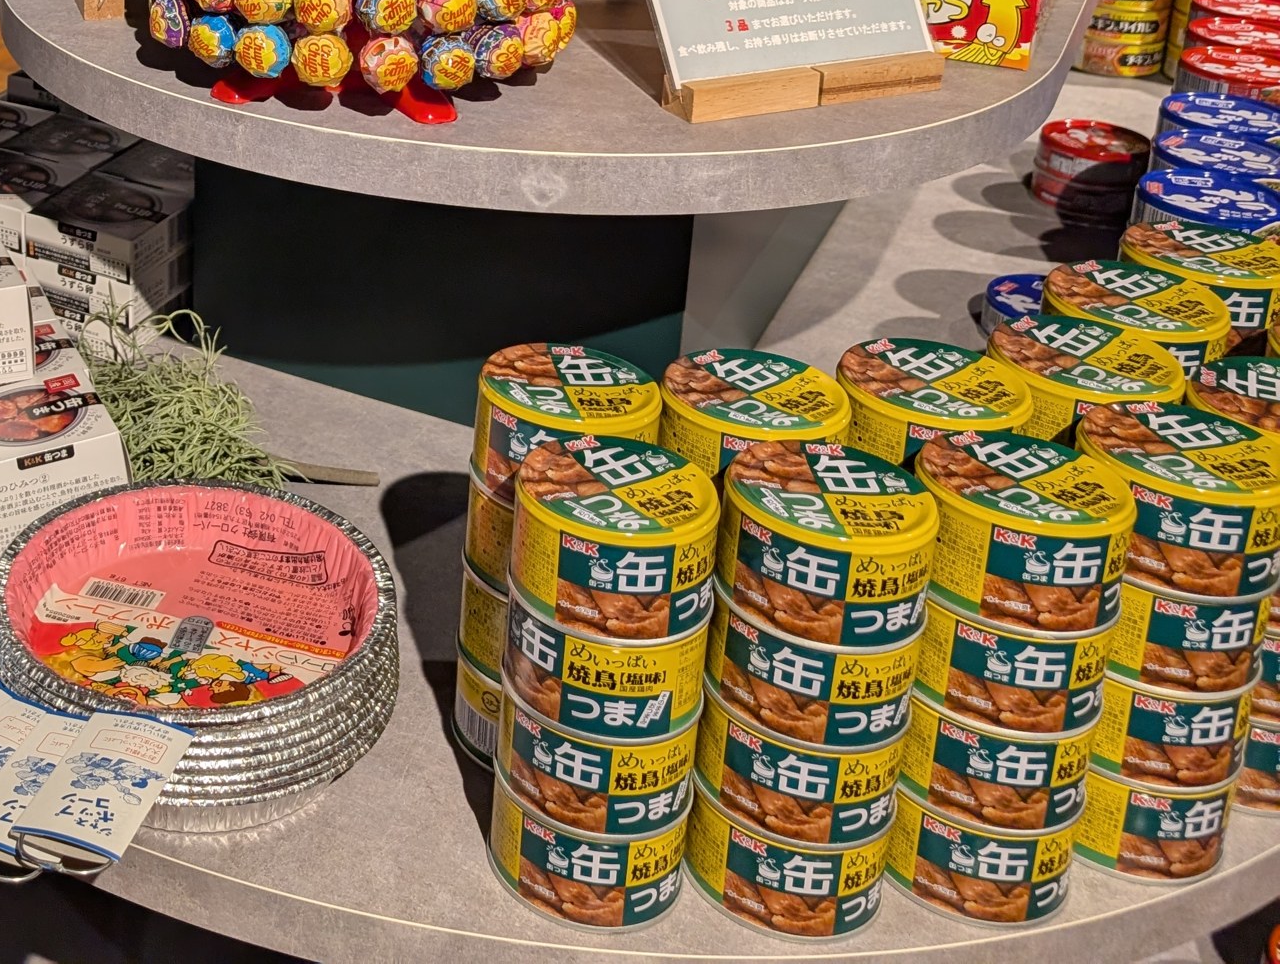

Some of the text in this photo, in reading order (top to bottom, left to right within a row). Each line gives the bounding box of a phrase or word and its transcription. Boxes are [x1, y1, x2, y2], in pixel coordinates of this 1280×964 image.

[1091, 269, 1159, 299] 缶
[558, 356, 614, 385] 缶
[712, 358, 779, 392] 缶
[565, 435, 601, 452] K&K
[1147, 413, 1222, 449] 缶
[24, 449, 68, 466] K&K 缶つま
[584, 447, 652, 486] 缶
[814, 455, 881, 494] 缶
[1132, 484, 1174, 510] K&K
[192, 518, 239, 535] クローバー
[742, 516, 772, 545] K&K
[994, 527, 1037, 550] K&K
[1188, 507, 1243, 552] 缶
[562, 534, 599, 558] K&K
[616, 551, 667, 593] 缶
[761, 567, 782, 581] 缶つま
[786, 546, 840, 596] 缶
[1022, 572, 1047, 582] 缶つま
[1053, 542, 1102, 585] 缶
[589, 579, 613, 590] 缶つま
[53, 598, 174, 633] ポップコーン
[850, 602, 912, 633] つま
[1155, 598, 1198, 619] K&K
[1182, 639, 1207, 650] 缶つま
[1211, 610, 1254, 650] 缶
[210, 632, 275, 660] ジャズ
[521, 619, 557, 672] 缶
[571, 644, 656, 669] めいっぱい
[279, 651, 333, 673] ローバー
[567, 693, 638, 726] つま
[618, 744, 687, 769] めいっぱい
[614, 790, 673, 824] つま
[923, 816, 961, 843] K&K
[977, 841, 1028, 881] 缶
